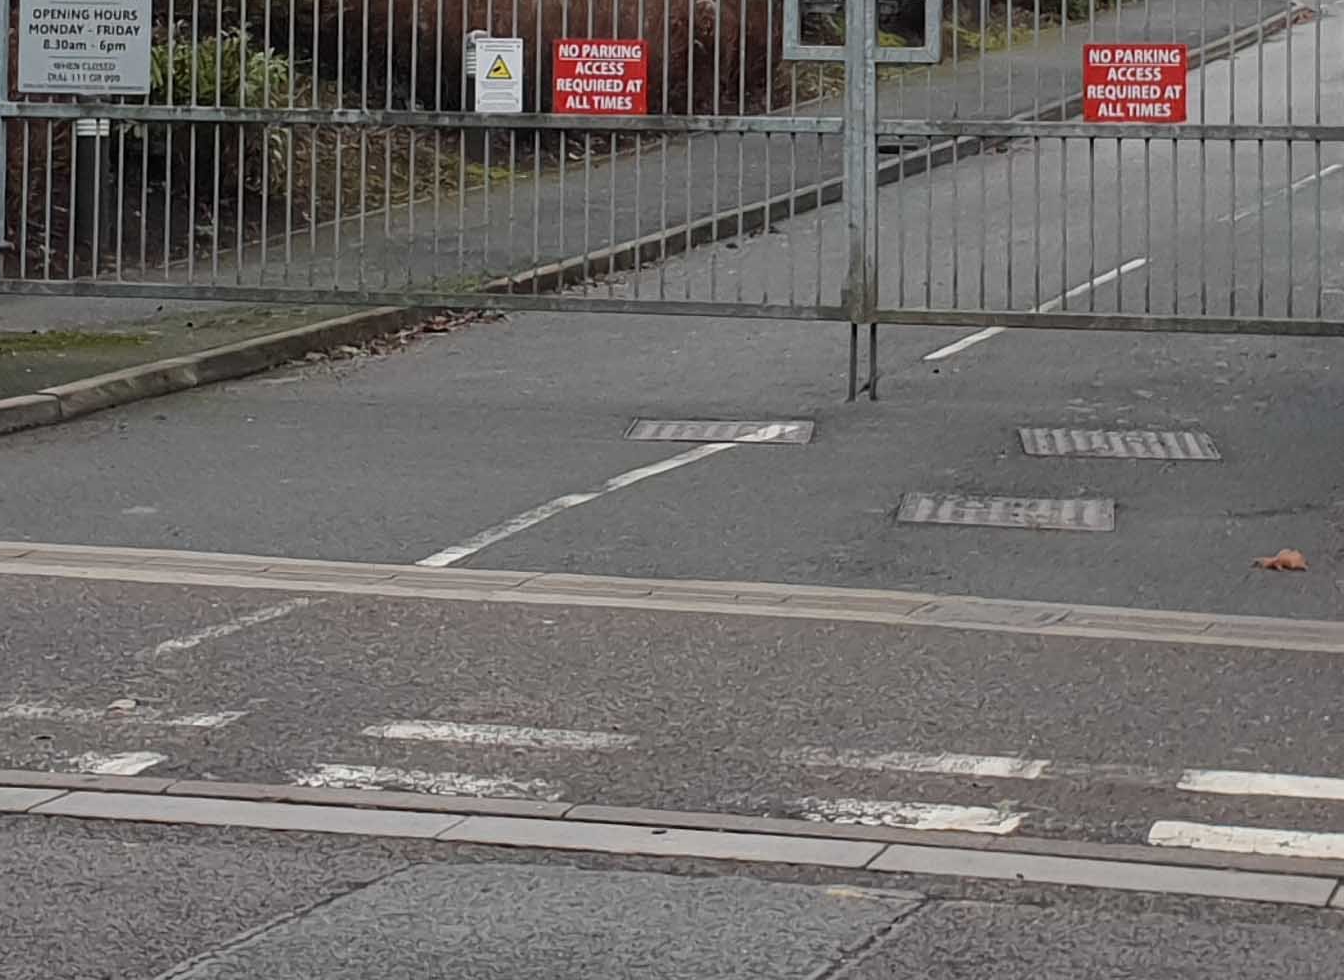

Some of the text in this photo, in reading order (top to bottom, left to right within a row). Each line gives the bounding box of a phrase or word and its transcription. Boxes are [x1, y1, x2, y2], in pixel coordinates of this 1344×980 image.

[32, 8, 138, 21] OPENING HOURS
[28, 24, 84, 35] MONDAY
[96, 25, 141, 36] FRIDAY
[43, 39, 87, 51] 8.30am
[99, 40, 126, 53] 6pm
[559, 44, 642, 59] NO PARKING
[1089, 49, 1181, 63] NO PARKING
[575, 62, 624, 76] ACCESS
[1107, 67, 1162, 81] ACCESS
[557, 79, 643, 93] REQUIRED AT
[1087, 85, 1183, 100] REQUIRED AT
[566, 95, 632, 110] ALL TIMES
[1098, 103, 1171, 117] ALL TIMES
